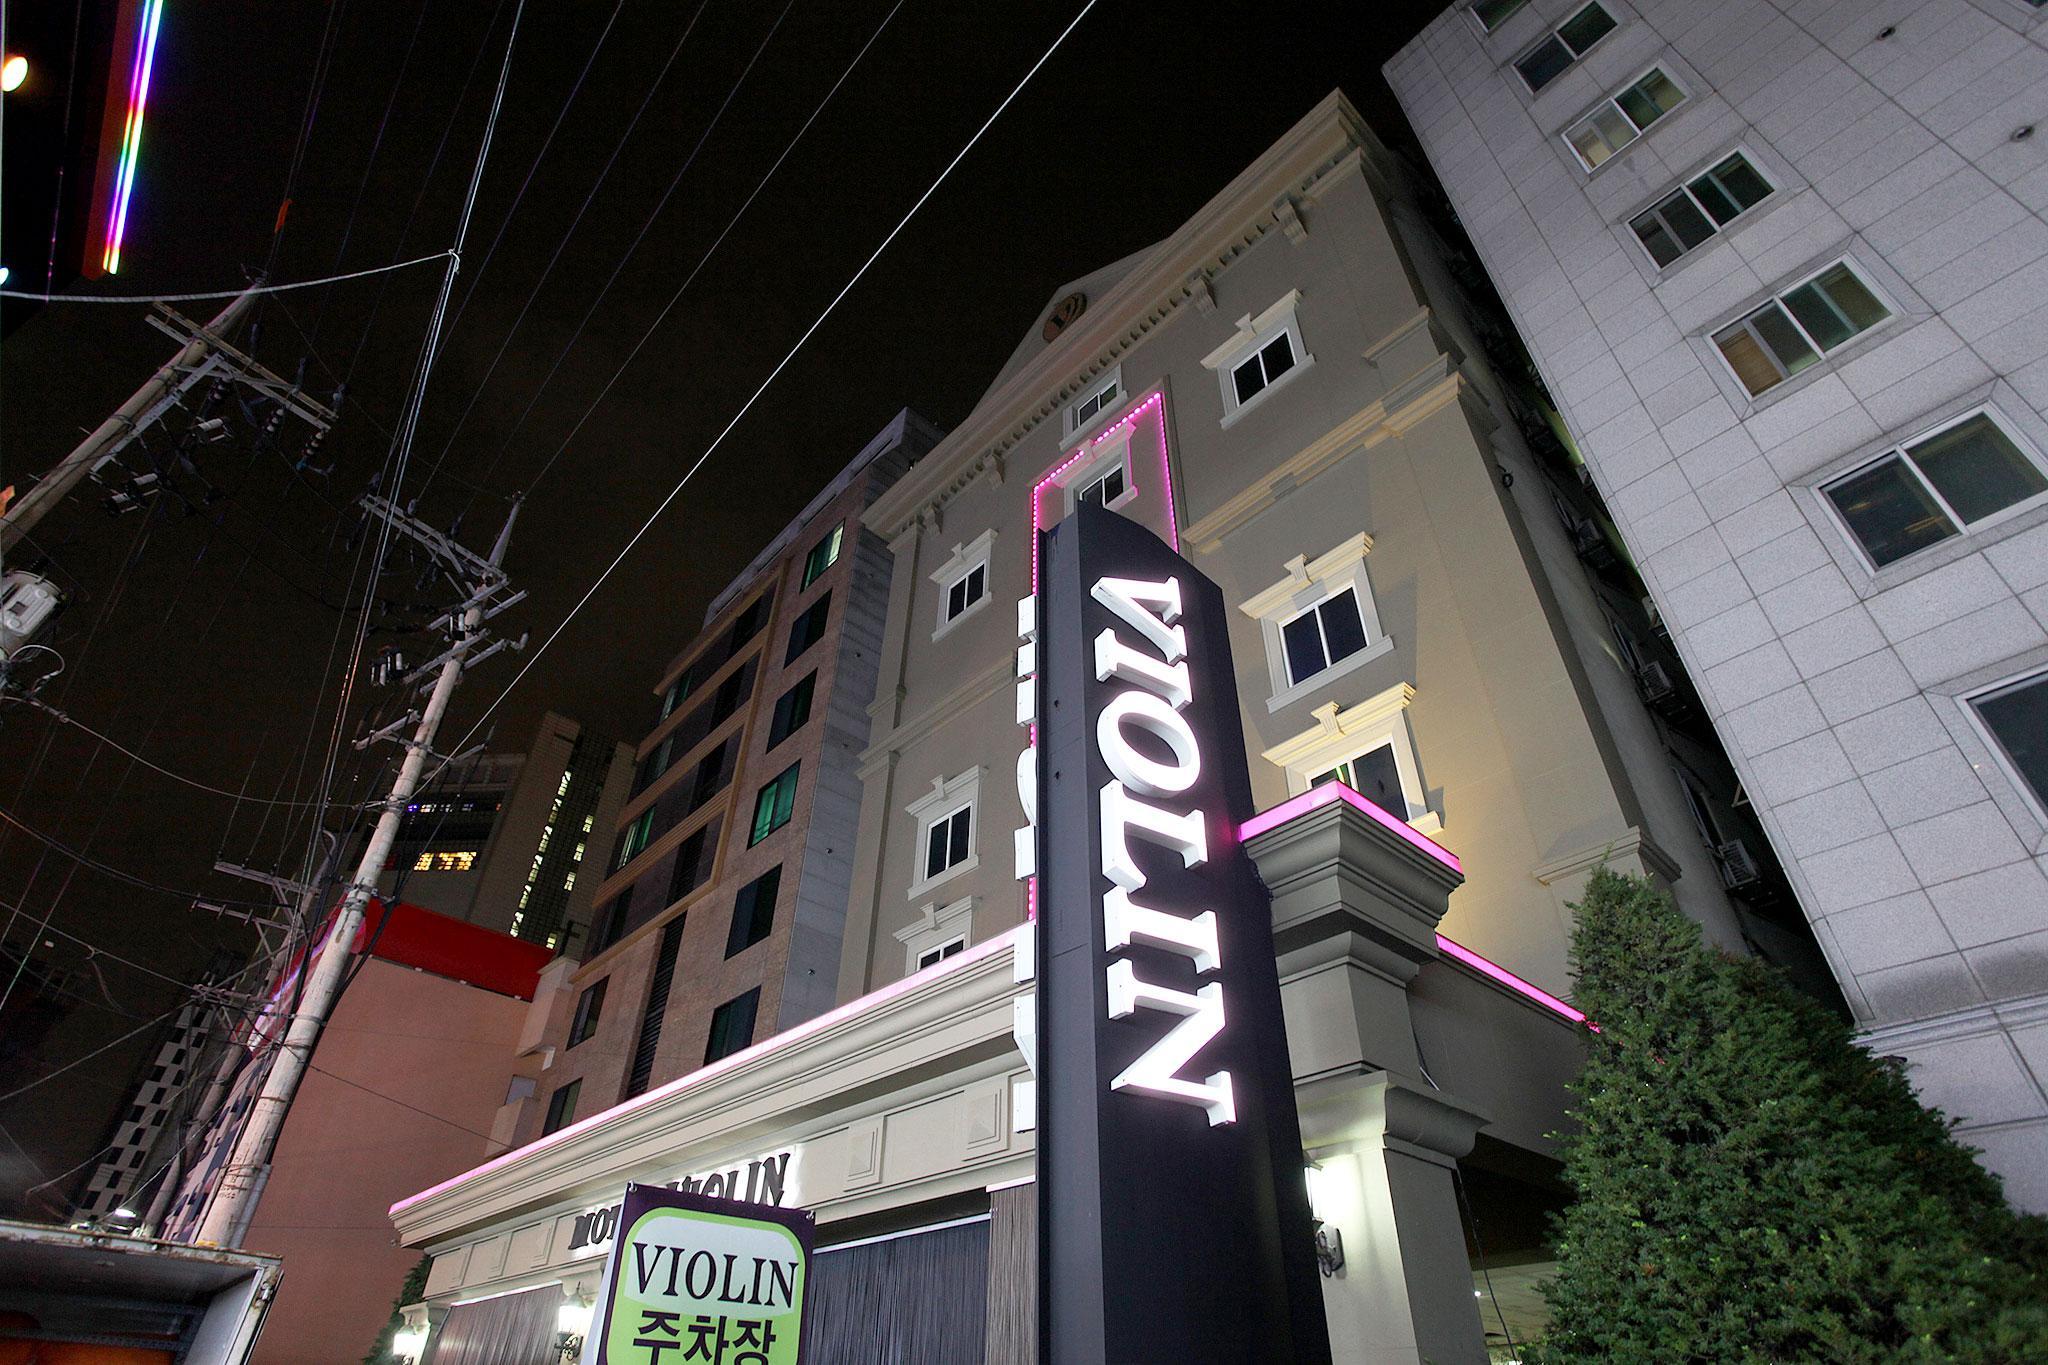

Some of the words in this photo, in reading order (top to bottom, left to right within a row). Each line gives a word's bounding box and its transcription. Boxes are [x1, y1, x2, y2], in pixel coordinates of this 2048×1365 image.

[1090, 576, 1238, 1128] VIOLIN
[632, 1241, 799, 1309] VIOLIN
[633, 1309, 777, 1365] 주차장
